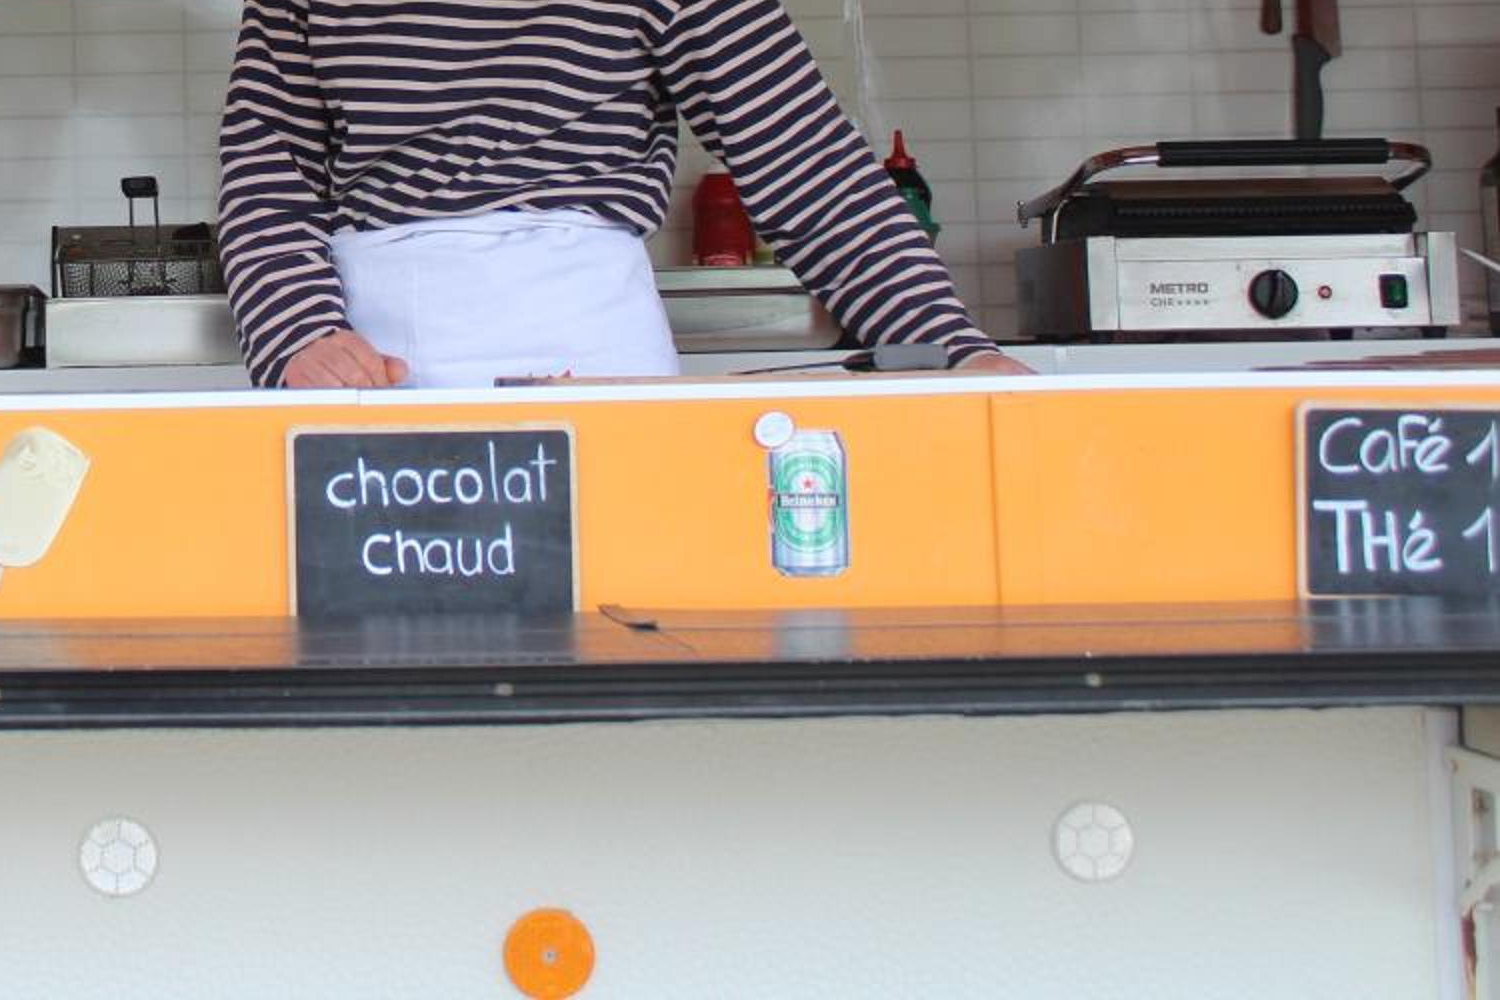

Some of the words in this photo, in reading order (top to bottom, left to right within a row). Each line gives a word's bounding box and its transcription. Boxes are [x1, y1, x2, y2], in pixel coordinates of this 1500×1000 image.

[1149, 283, 1208, 295] METRO
[326, 440, 557, 508] chocolat
[362, 522, 516, 577] chaud
